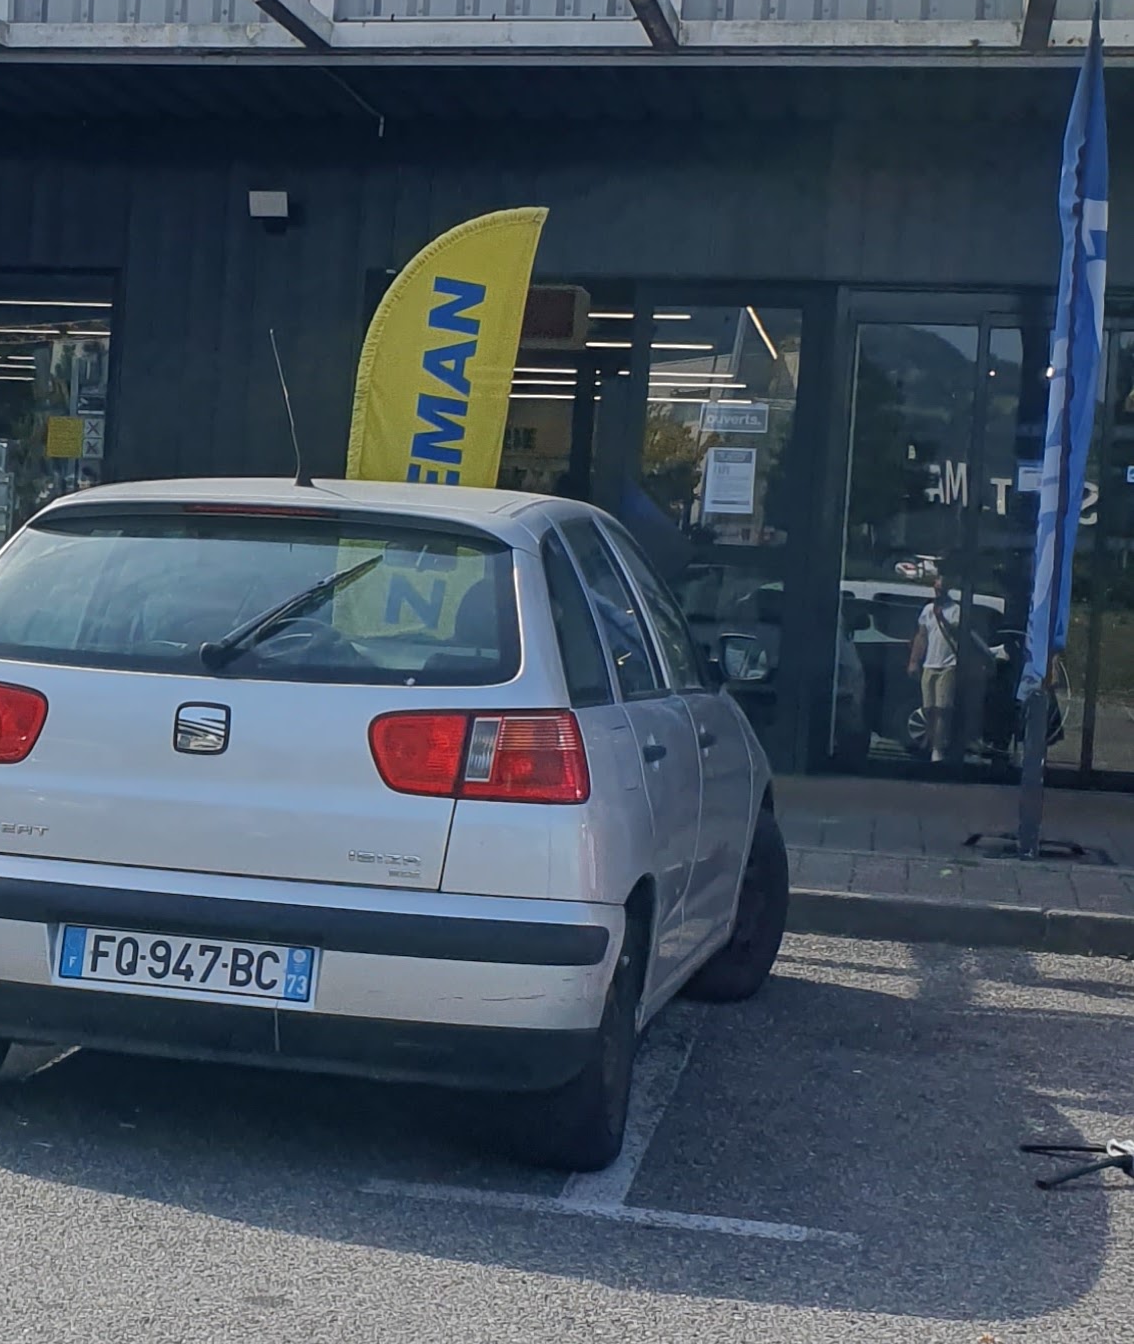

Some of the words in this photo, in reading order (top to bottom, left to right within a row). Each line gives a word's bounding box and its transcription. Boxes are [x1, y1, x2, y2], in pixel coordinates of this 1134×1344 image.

[68, 956, 76, 969] F
[89, 934, 281, 991] FQ-947-BC
[286, 973, 308, 995] 73
